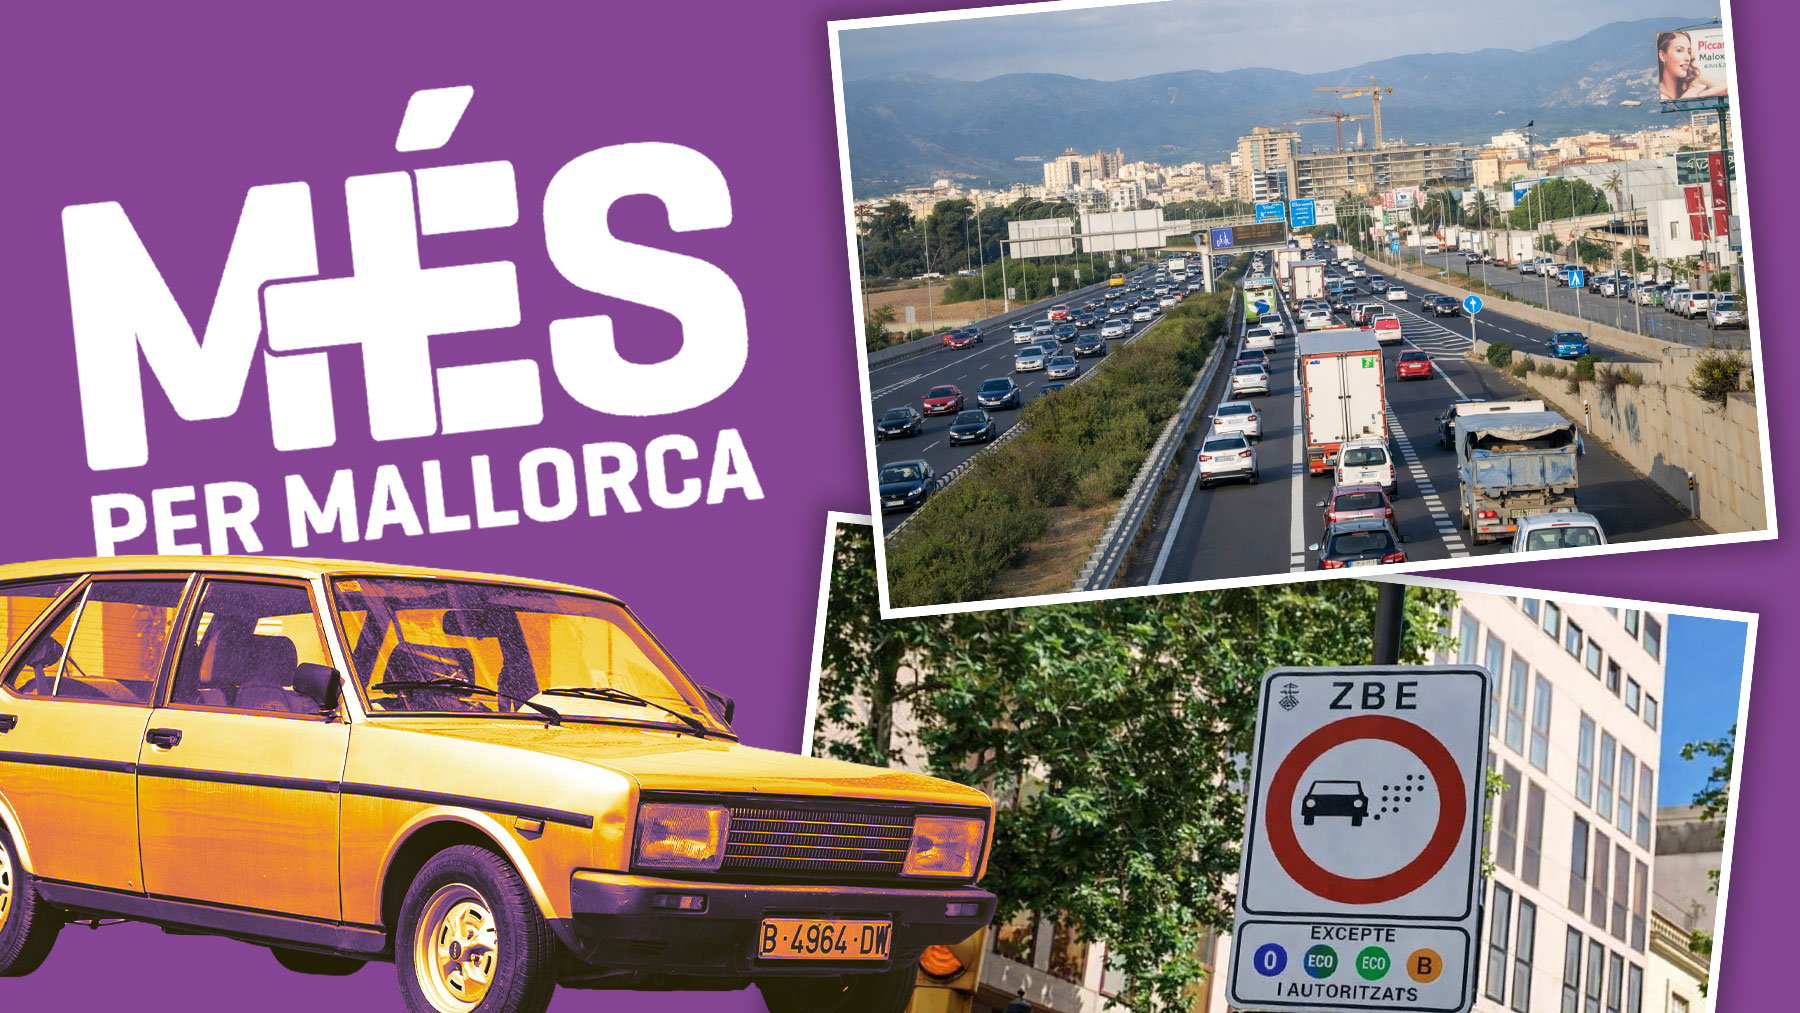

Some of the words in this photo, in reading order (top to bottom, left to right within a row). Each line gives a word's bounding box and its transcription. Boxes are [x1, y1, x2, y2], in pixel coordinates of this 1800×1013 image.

[1329, 681, 1419, 710] ZBE
[1310, 925, 1396, 943] EXCEPTE
[1307, 952, 1334, 969] ECO
[1361, 956, 1386, 971] ECO
[1416, 956, 1433, 975] B
[1276, 981, 1282, 996] I
[1287, 982, 1418, 1002] AUTORITZATS
